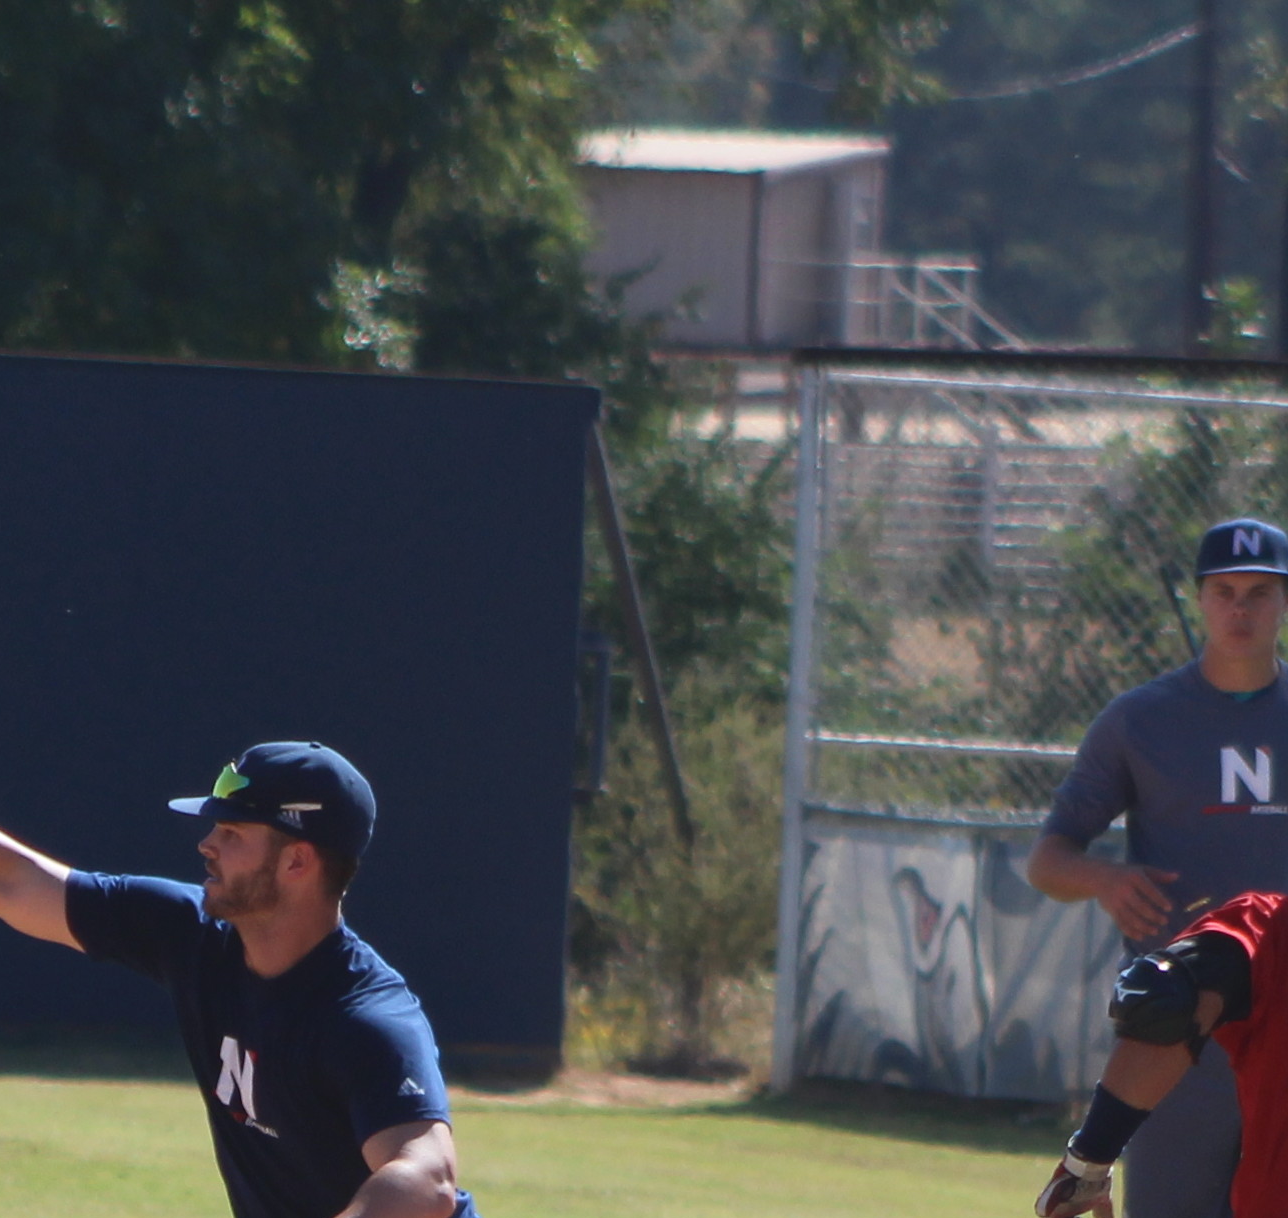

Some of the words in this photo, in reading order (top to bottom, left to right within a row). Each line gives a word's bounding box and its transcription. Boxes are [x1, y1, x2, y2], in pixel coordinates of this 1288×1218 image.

[1233, 529, 1260, 556] N
[1220, 746, 1271, 803] N
[215, 1035, 257, 1121] N
